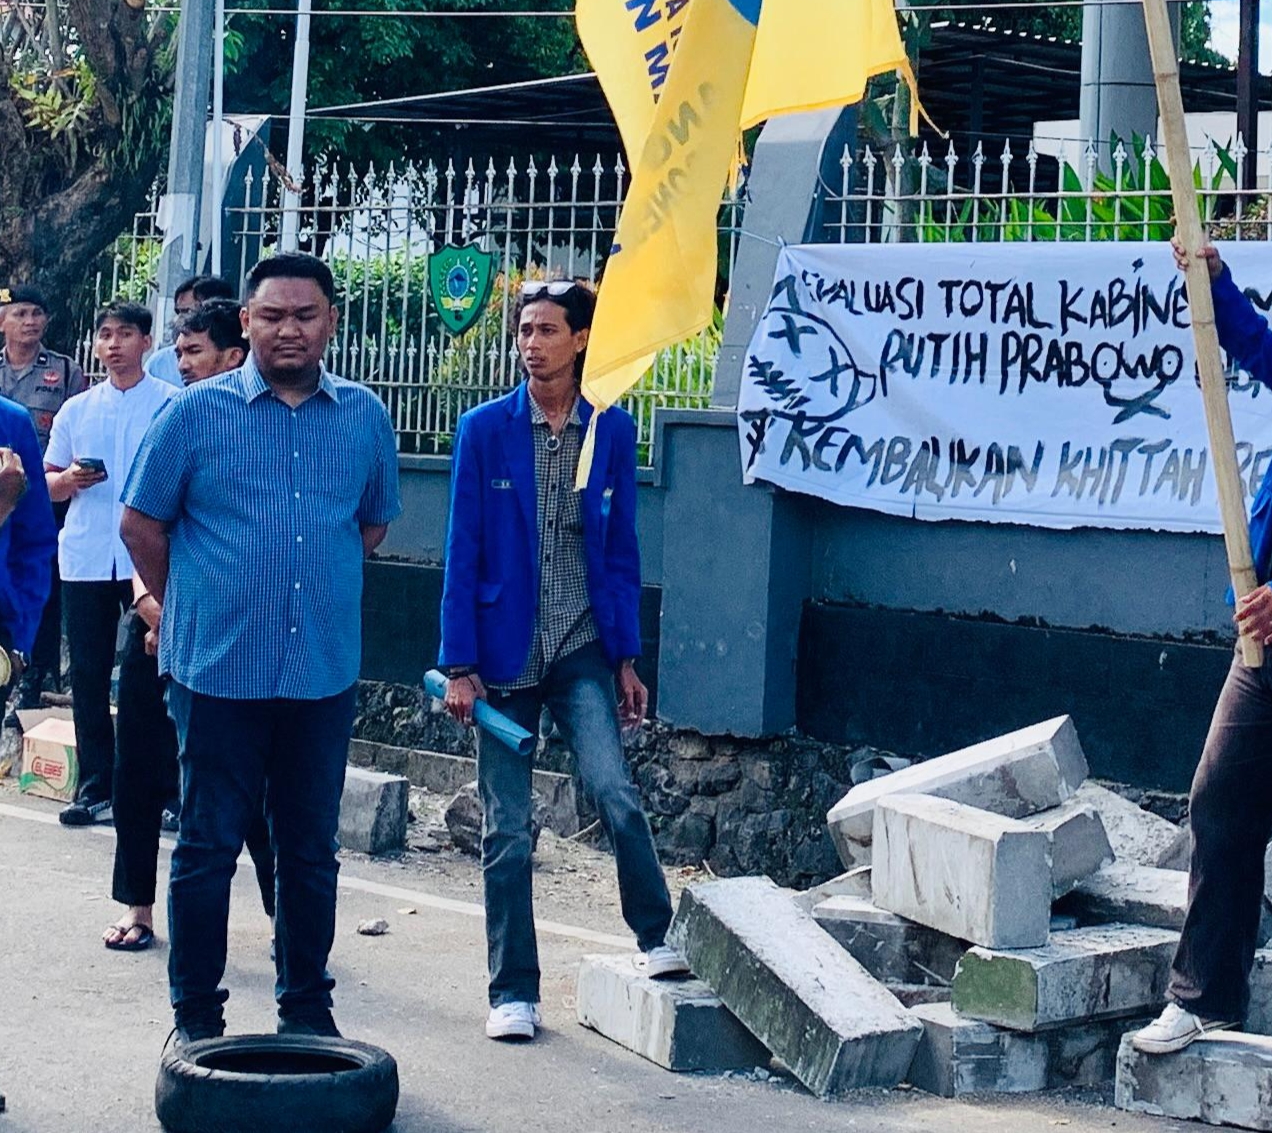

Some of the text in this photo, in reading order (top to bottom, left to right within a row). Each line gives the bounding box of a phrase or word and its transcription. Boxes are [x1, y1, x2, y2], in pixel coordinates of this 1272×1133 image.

[937, 278, 1053, 329] TOTAL
[1059, 257, 1191, 338] KABINE
[880, 328, 988, 397] PUTIH
